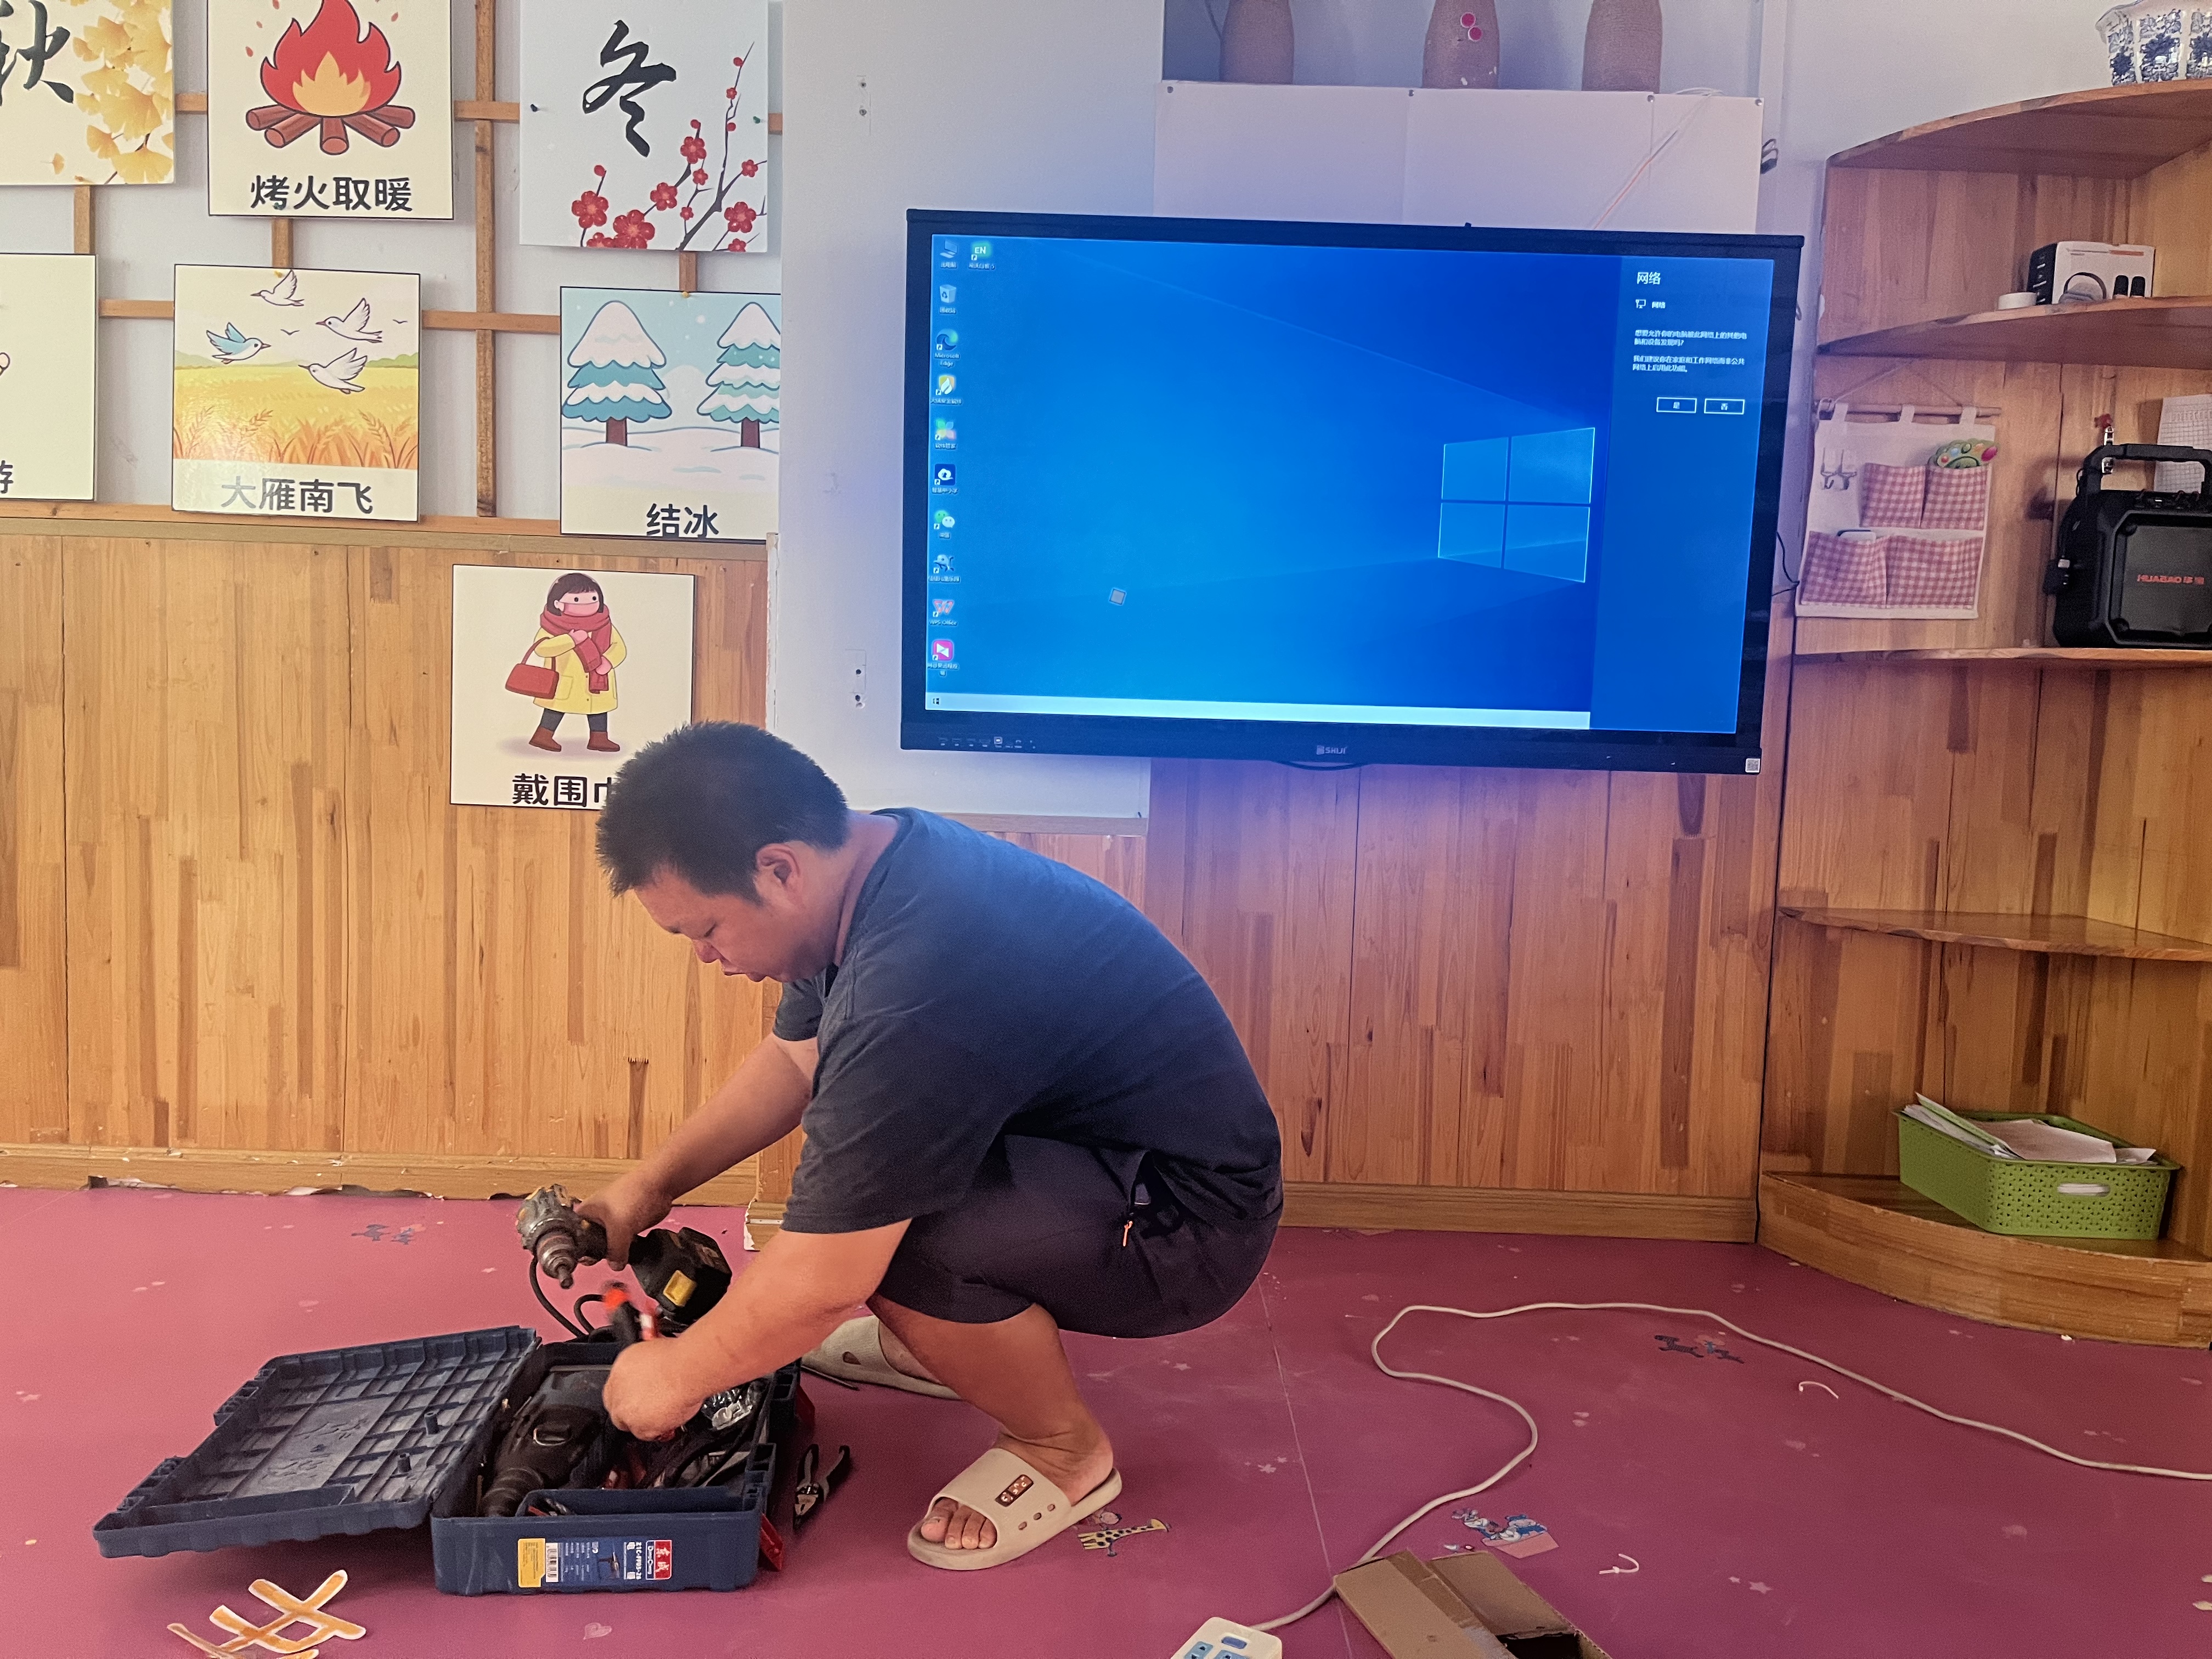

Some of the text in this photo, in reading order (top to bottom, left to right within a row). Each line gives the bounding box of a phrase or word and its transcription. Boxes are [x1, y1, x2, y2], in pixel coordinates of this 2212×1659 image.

[582, 20, 676, 157] 冬
[250, 175, 413, 212] 烤火取暖
[1637, 272, 1661, 285] 网络
[221, 476, 374, 514] 大雁南飞
[646, 503, 719, 538] 结冰
